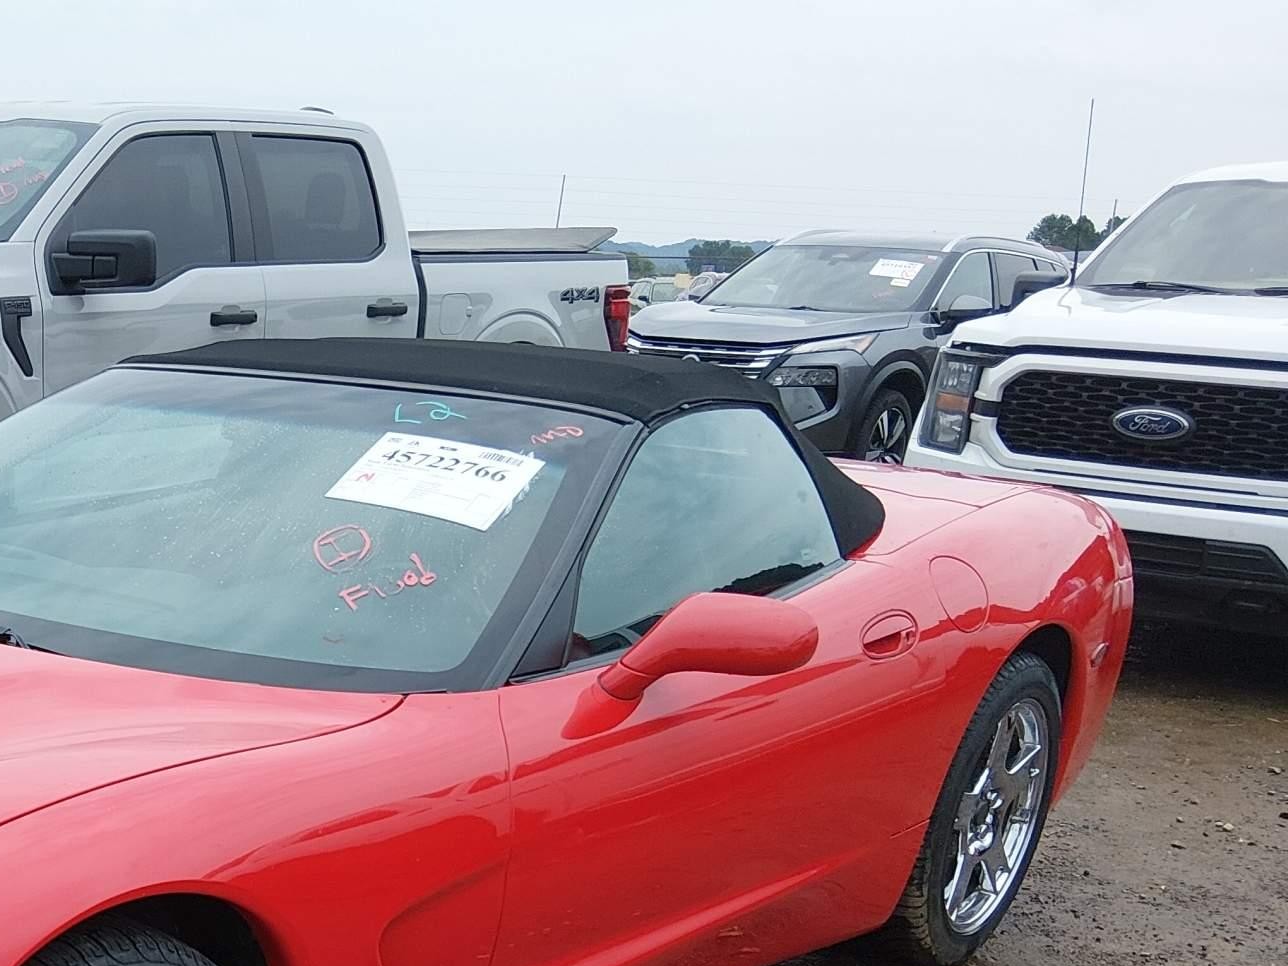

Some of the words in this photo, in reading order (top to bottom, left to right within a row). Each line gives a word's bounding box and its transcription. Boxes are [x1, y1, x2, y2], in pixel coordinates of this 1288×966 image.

[560, 286, 600, 304] 4x4
[1128, 414, 1171, 433] Ford
[381, 448, 511, 482] 45722766
